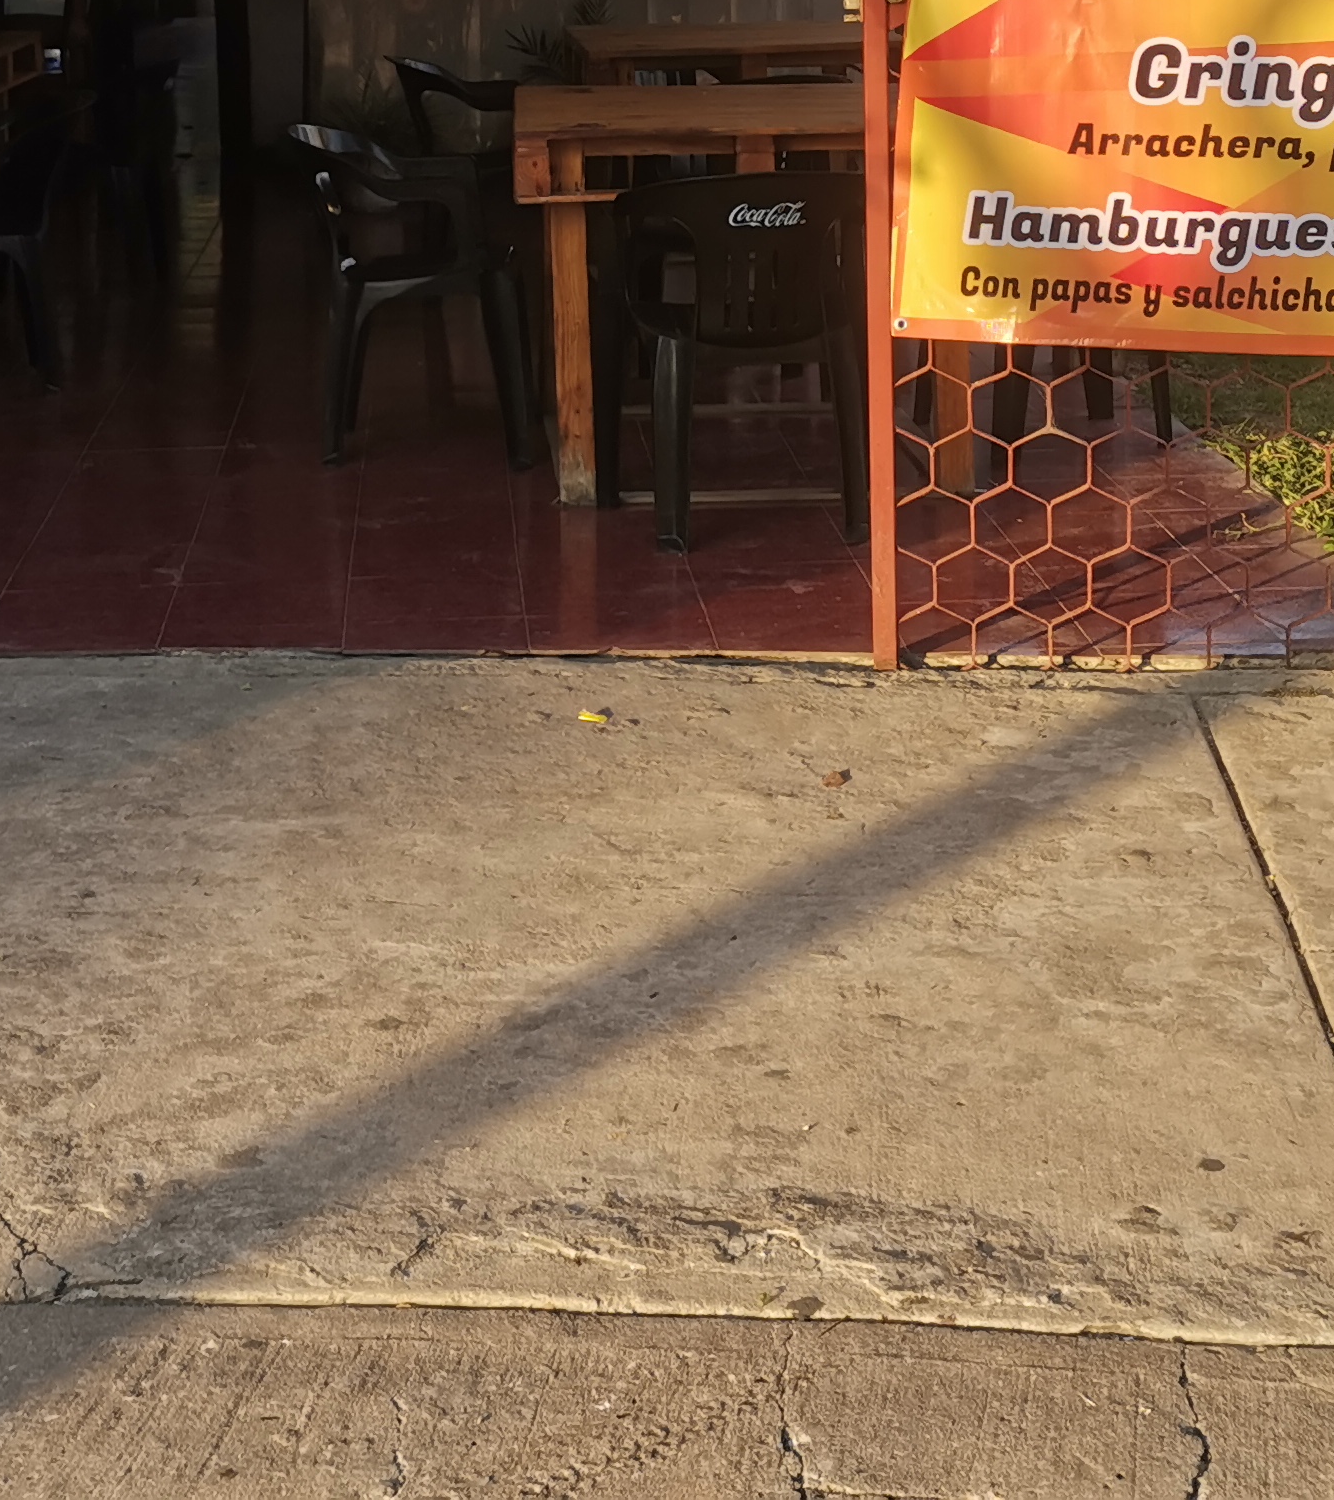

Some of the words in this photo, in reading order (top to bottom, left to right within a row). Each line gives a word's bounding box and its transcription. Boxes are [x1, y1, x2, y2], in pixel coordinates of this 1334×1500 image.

[1067, 122, 1316, 168] Arrachera,
[960, 265, 1021, 300] Con
[1028, 277, 1133, 314] papas
[1142, 282, 1164, 318] y
